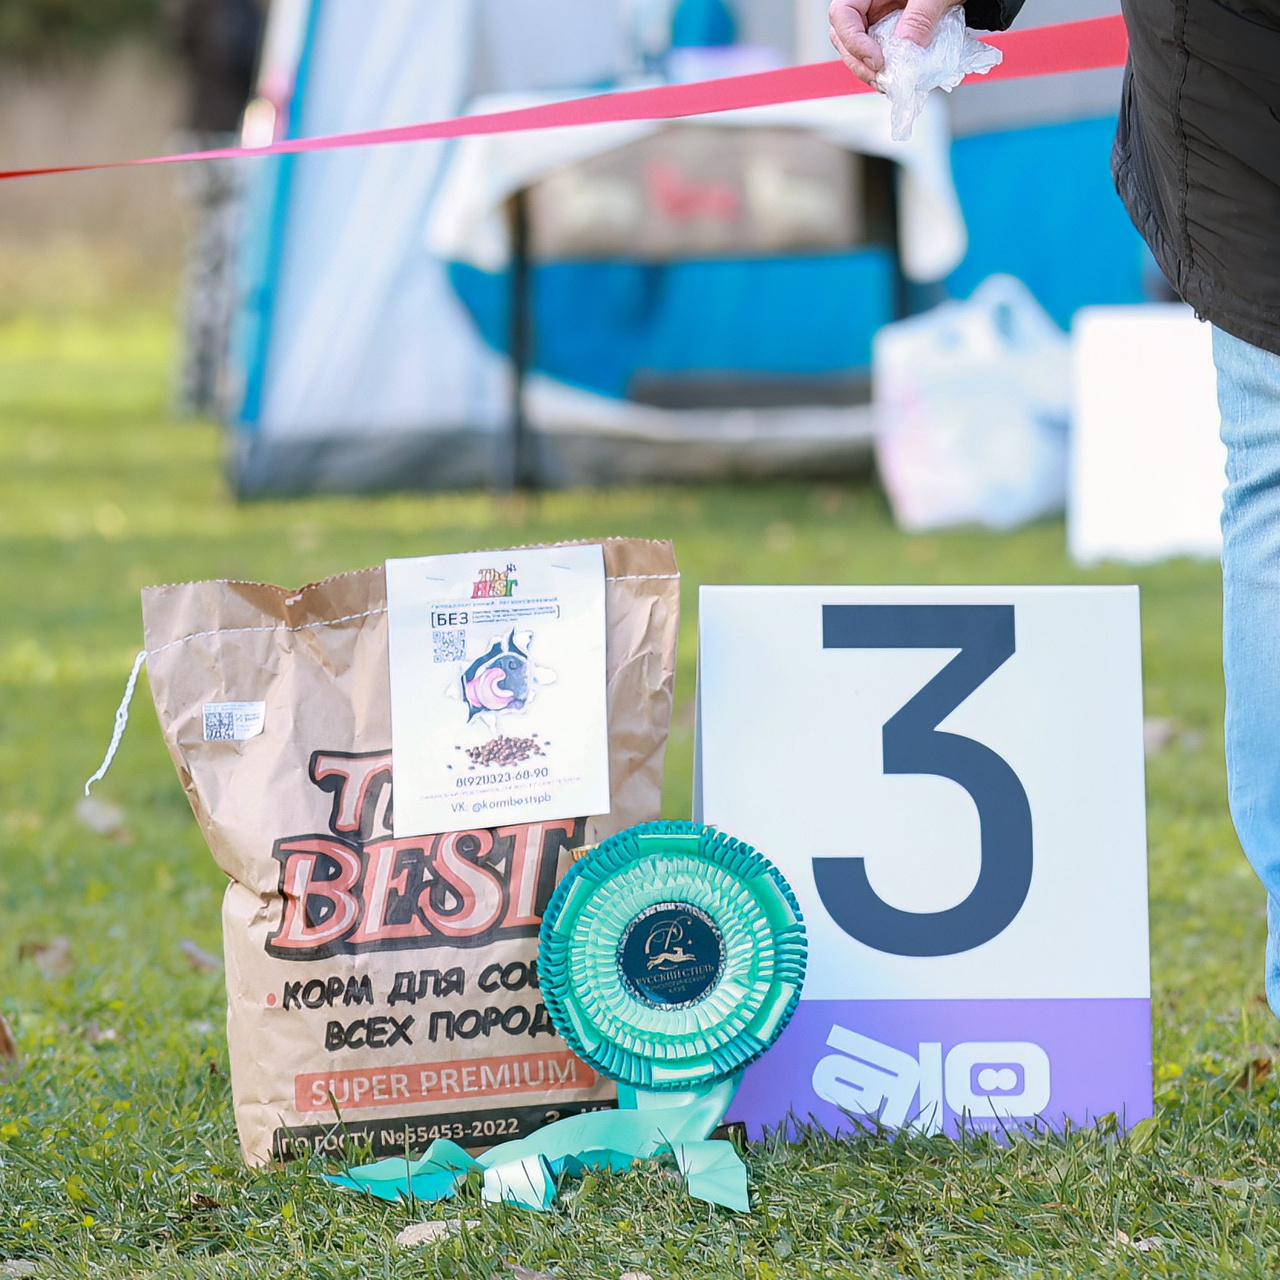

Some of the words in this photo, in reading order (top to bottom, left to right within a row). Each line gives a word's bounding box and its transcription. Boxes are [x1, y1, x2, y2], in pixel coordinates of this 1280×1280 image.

[471, 579, 518, 599] BEST
[812, 604, 1034, 958] 3
[266, 817, 586, 960] BEST
[282, 974, 374, 1011] КОРМ
[387, 967, 465, 1007] ДЛЯ
[324, 1015, 415, 1052] ВСЕХ
[428, 1004, 556, 1043] ПОРОД
[312, 1073, 410, 1107] SUPER
[420, 1058, 578, 1096] PREMIUM
